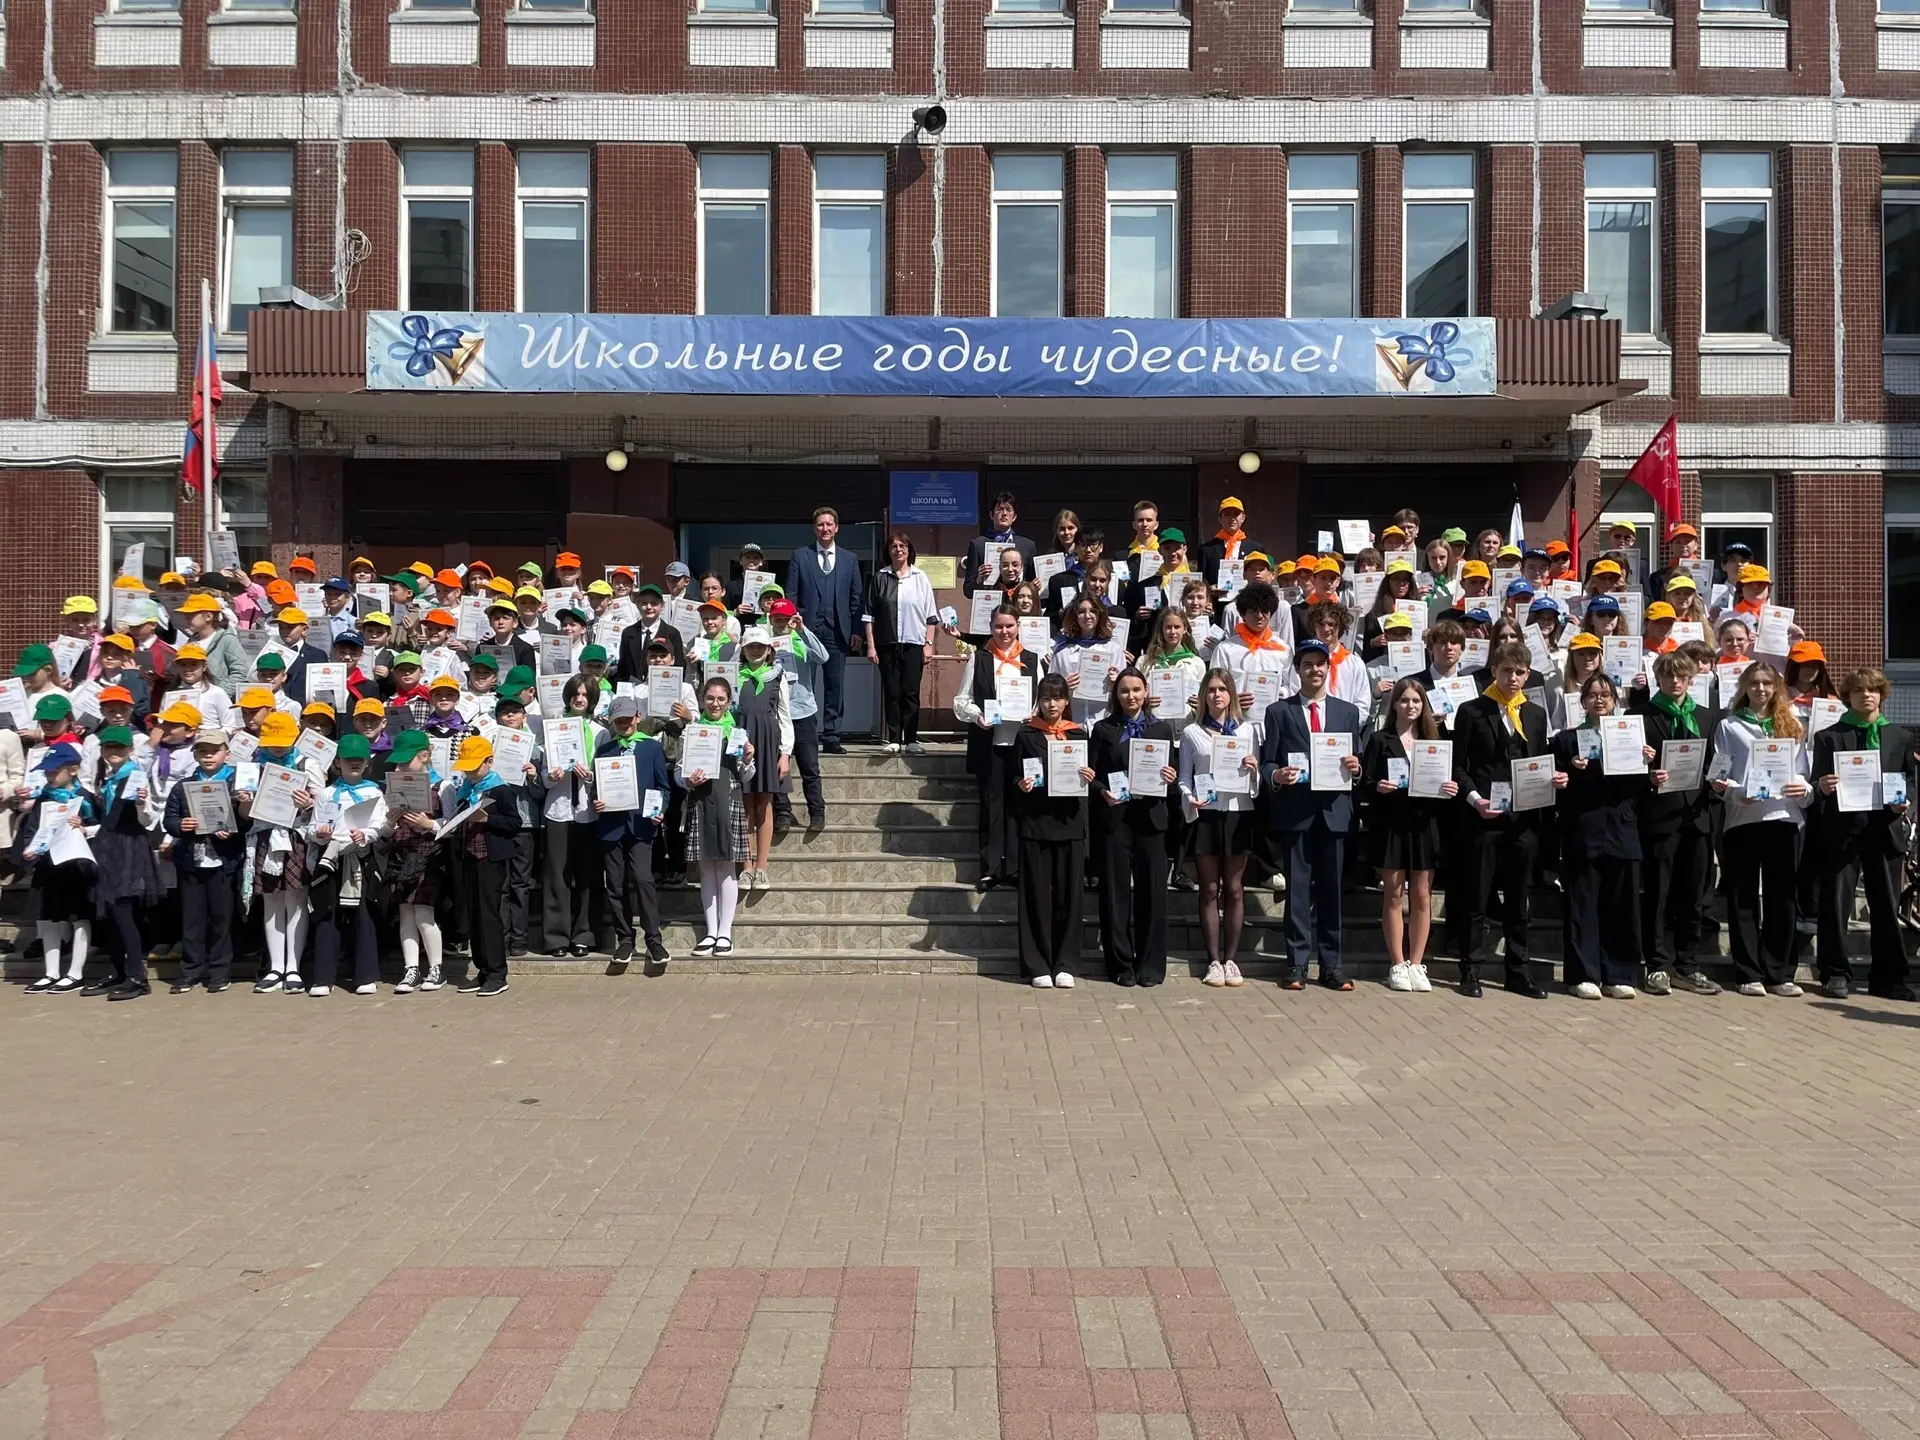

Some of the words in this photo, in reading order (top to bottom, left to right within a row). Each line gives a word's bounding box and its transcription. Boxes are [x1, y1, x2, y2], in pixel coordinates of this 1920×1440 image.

[518, 323, 843, 370] Школьные
[873, 327, 1012, 373] годы
[1039, 328, 1343, 386] чудесные!
[911, 497, 939, 505] ШКОЛА
[940, 497, 957, 505] №31
